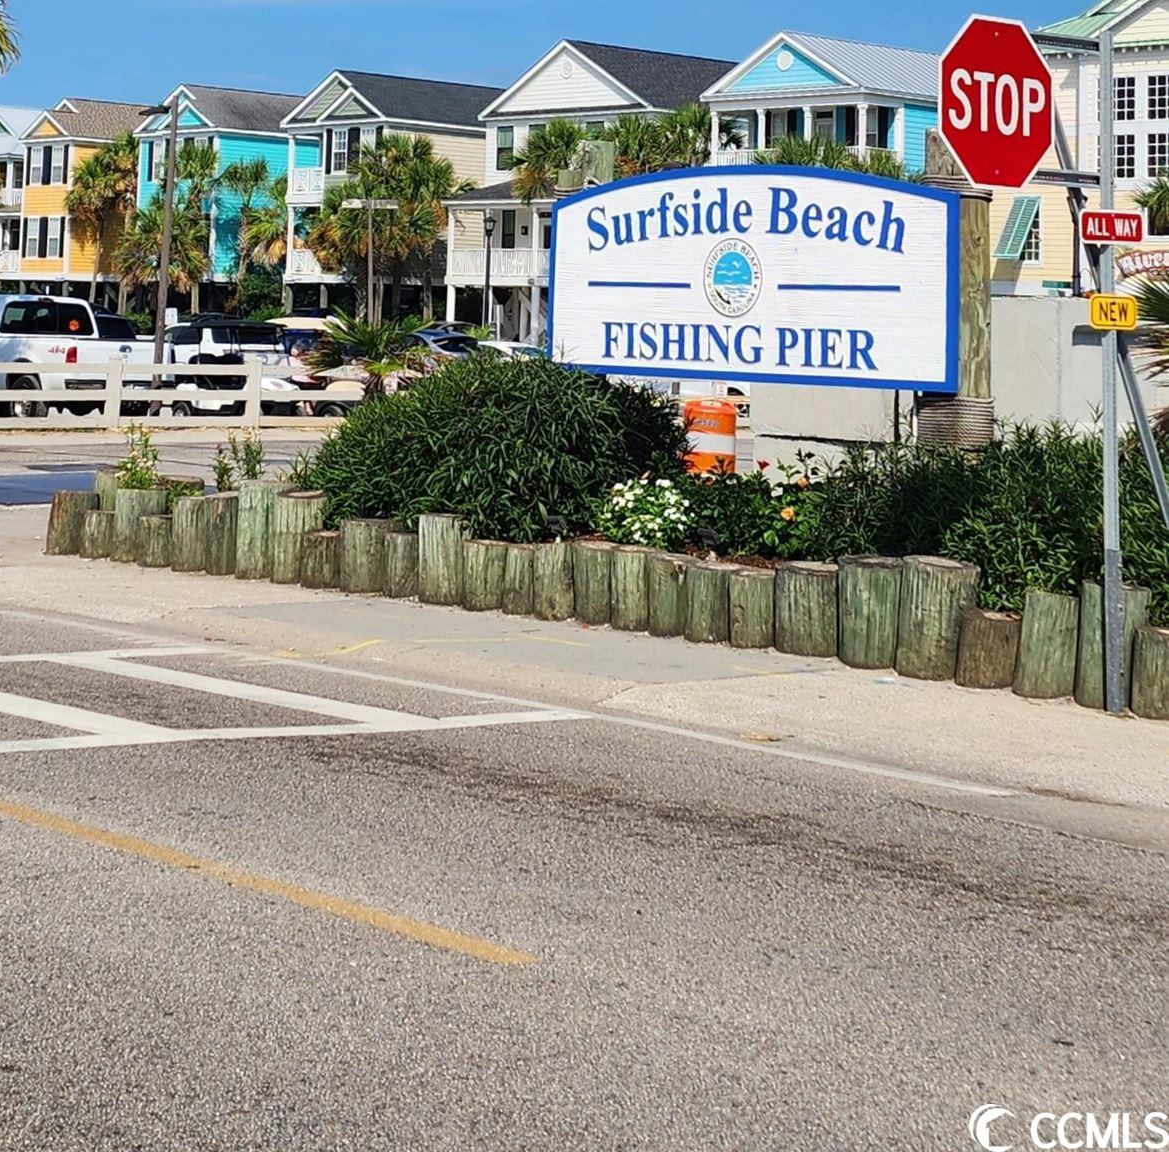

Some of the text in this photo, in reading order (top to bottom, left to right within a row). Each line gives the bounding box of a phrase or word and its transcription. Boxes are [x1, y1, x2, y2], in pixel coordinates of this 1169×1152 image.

[948, 68, 1046, 137] STOP
[587, 187, 907, 255] Surfside Beach
[1086, 217, 1139, 238] ALL WAY
[740, 245, 760, 280] BEACH
[1099, 301, 1129, 323] NEW
[602, 322, 880, 371] FISHING PIER
